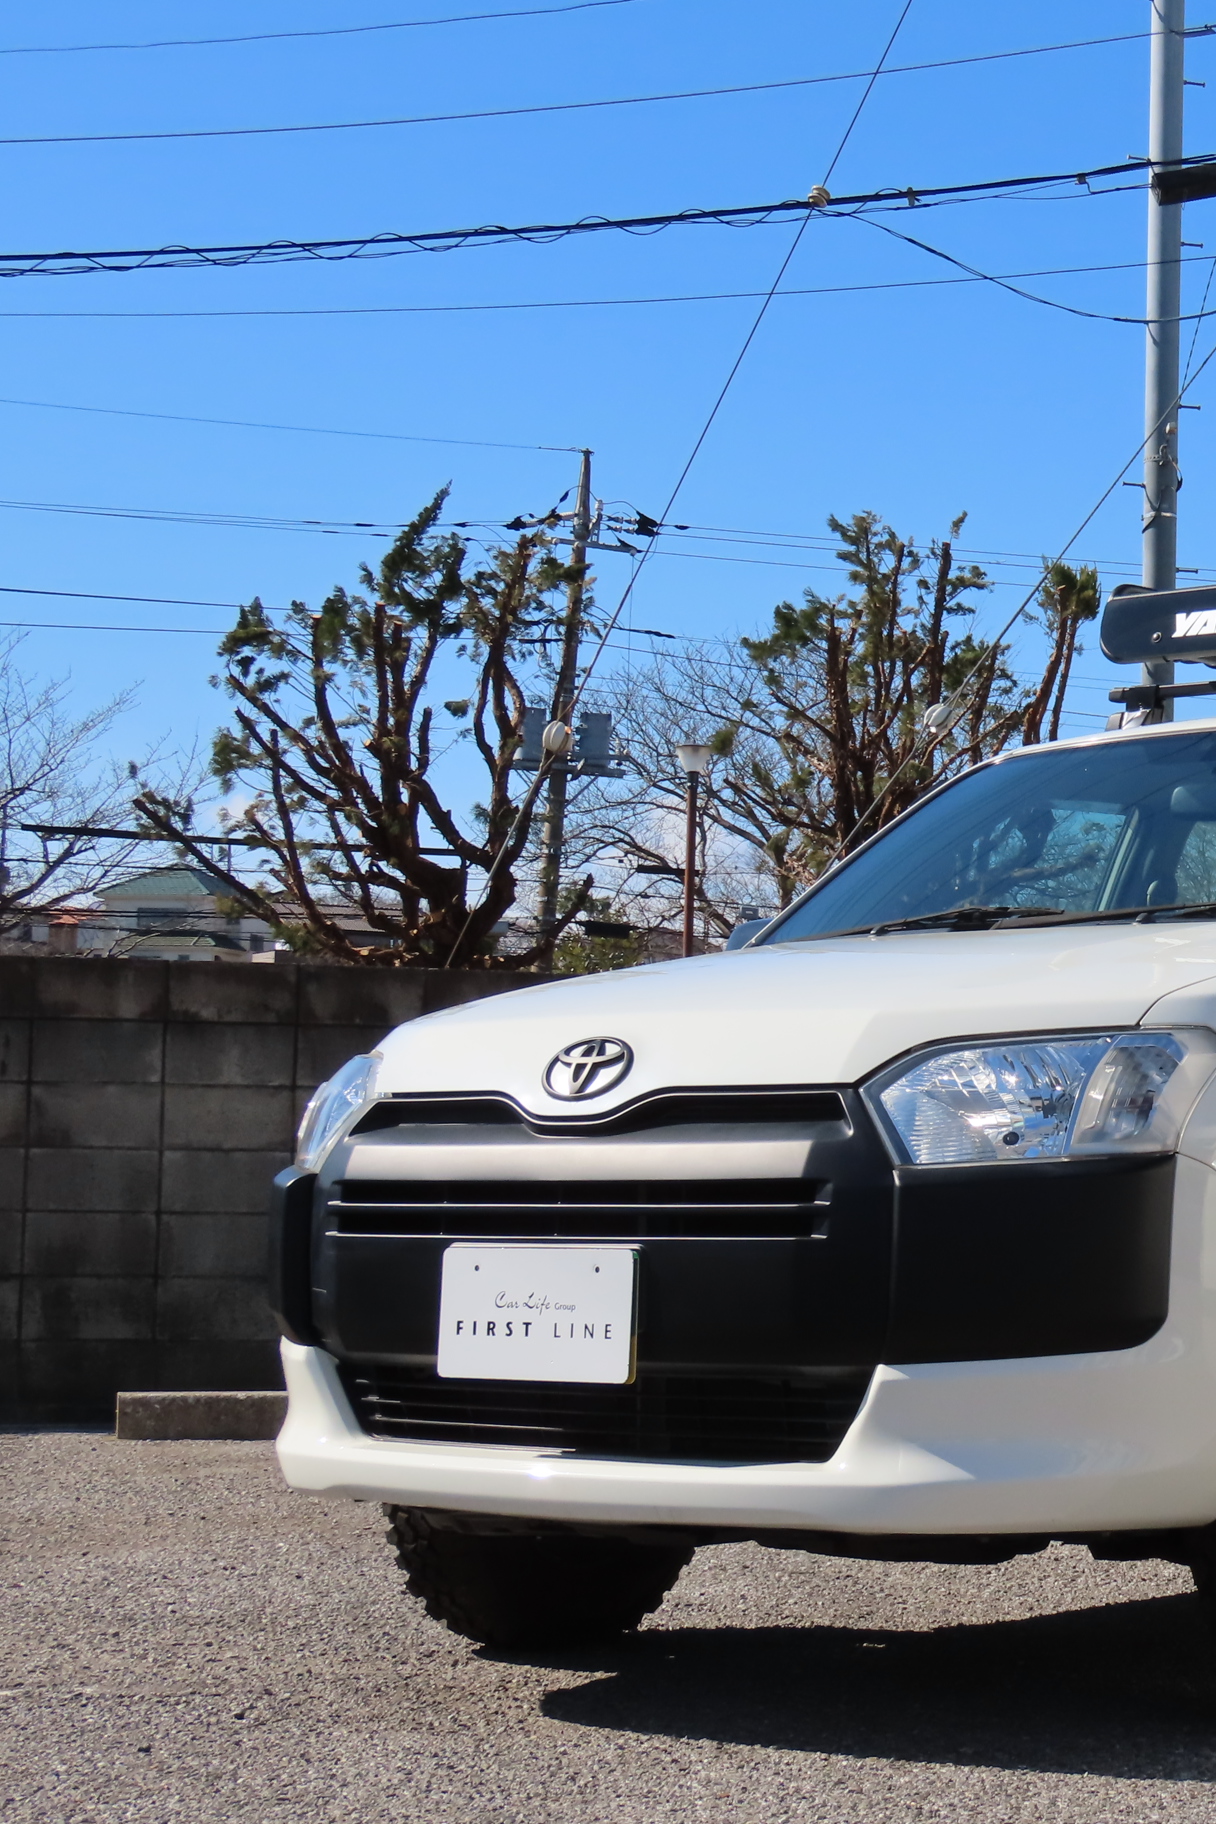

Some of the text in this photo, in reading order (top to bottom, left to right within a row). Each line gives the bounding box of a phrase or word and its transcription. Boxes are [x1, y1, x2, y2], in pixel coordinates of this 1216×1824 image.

[494, 1290, 577, 1316] Car Life Group
[456, 1320, 612, 1340] FIRST LINE
